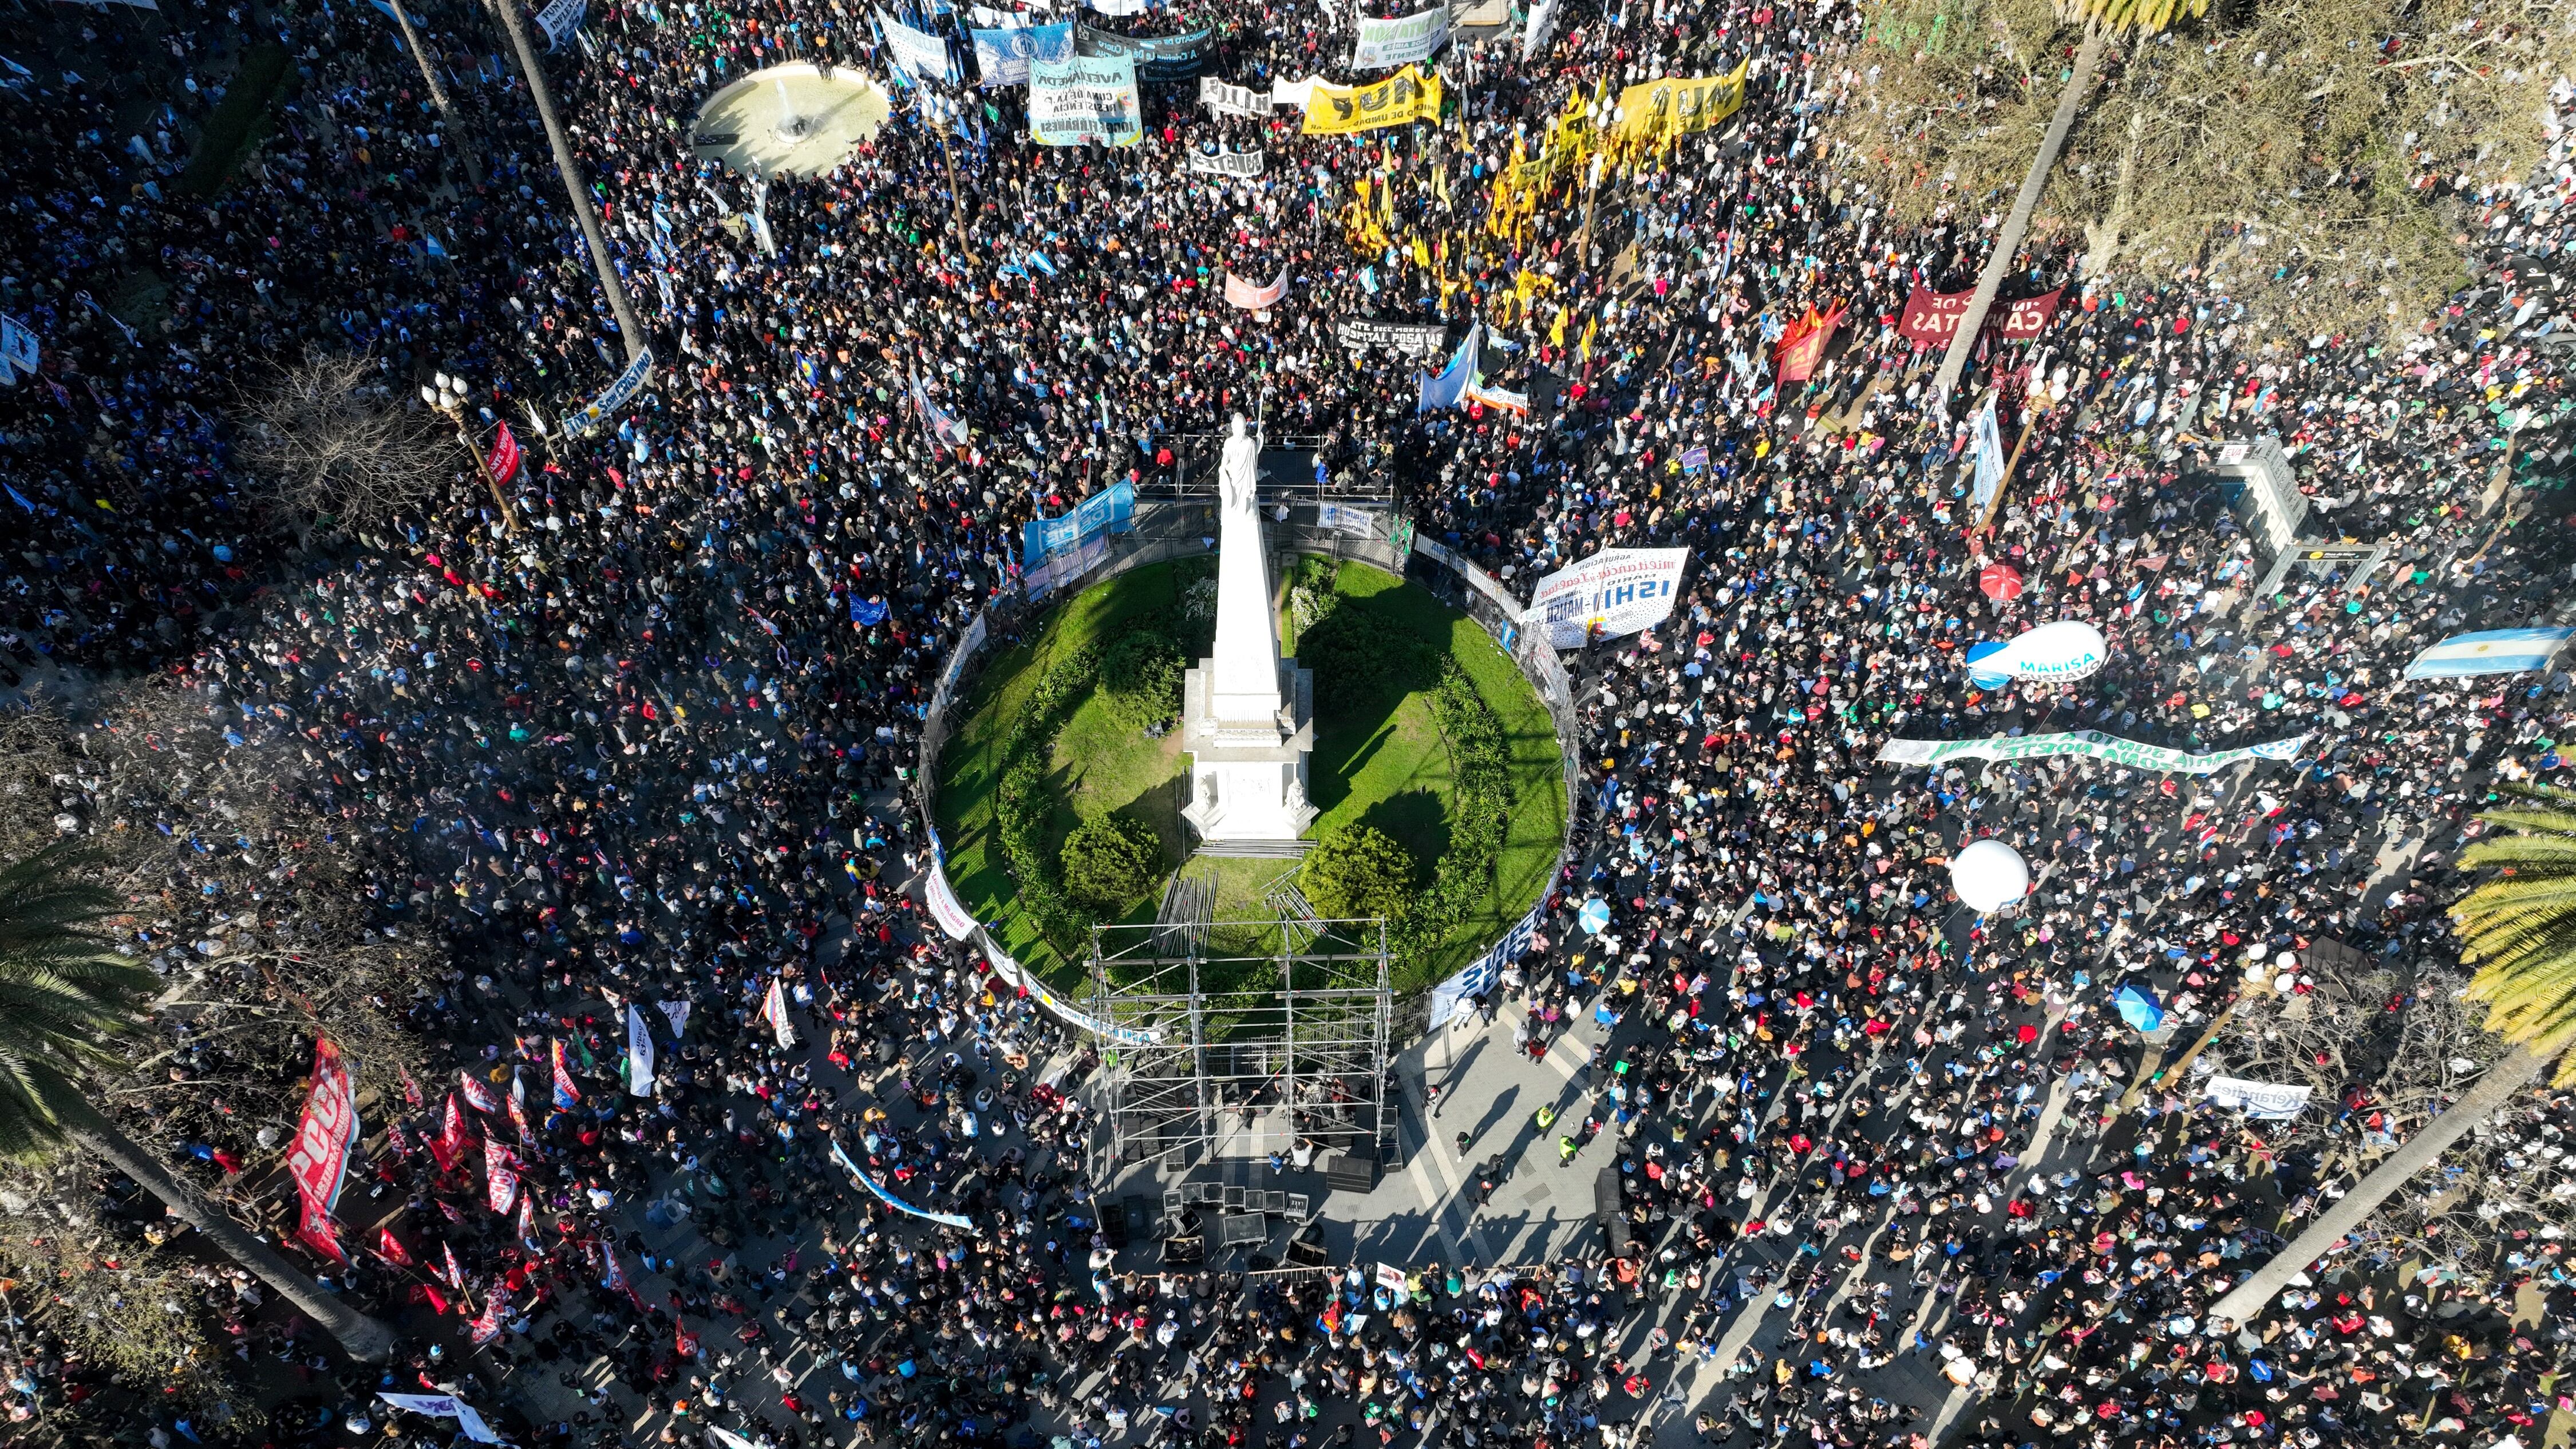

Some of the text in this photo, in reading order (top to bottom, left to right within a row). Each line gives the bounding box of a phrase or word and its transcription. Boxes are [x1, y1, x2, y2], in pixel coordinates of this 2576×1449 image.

[1337, 322, 1388, 342] HOSPITAL
[1349, 321, 1370, 331] ATE
[2225, 448, 2242, 457] EVA
[2019, 660, 2101, 682] GUSTAVO
[2020, 652, 2095, 673] MARISA
[943, 903, 966, 928] MILAGRO
